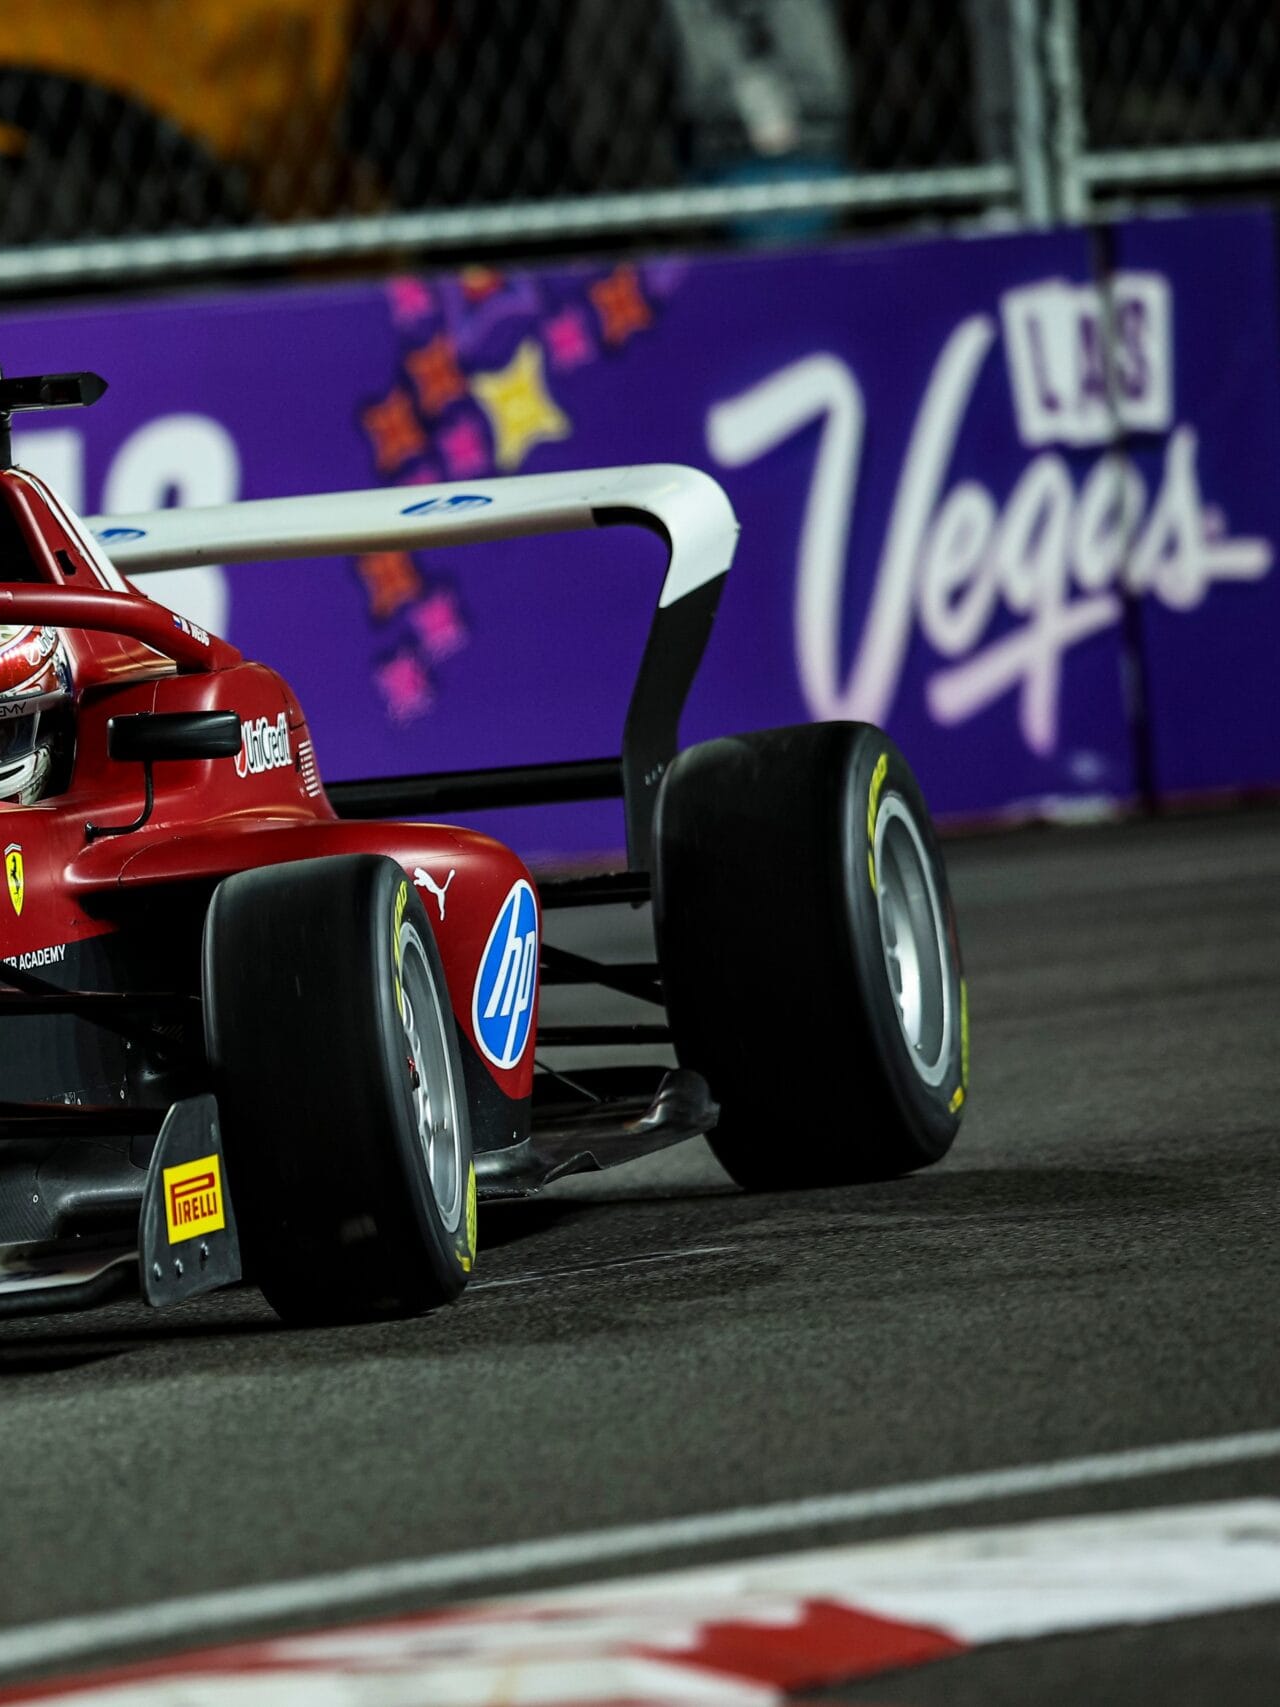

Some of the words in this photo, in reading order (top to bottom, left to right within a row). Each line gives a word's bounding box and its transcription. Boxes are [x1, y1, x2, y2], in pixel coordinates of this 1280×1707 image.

[706, 312, 1272, 758] Vegas
[243, 712, 293, 774] UniCredit
[19, 943, 67, 971] ACADEMY
[482, 882, 536, 1066] hp
[170, 1171, 218, 1227] PIRELLI
